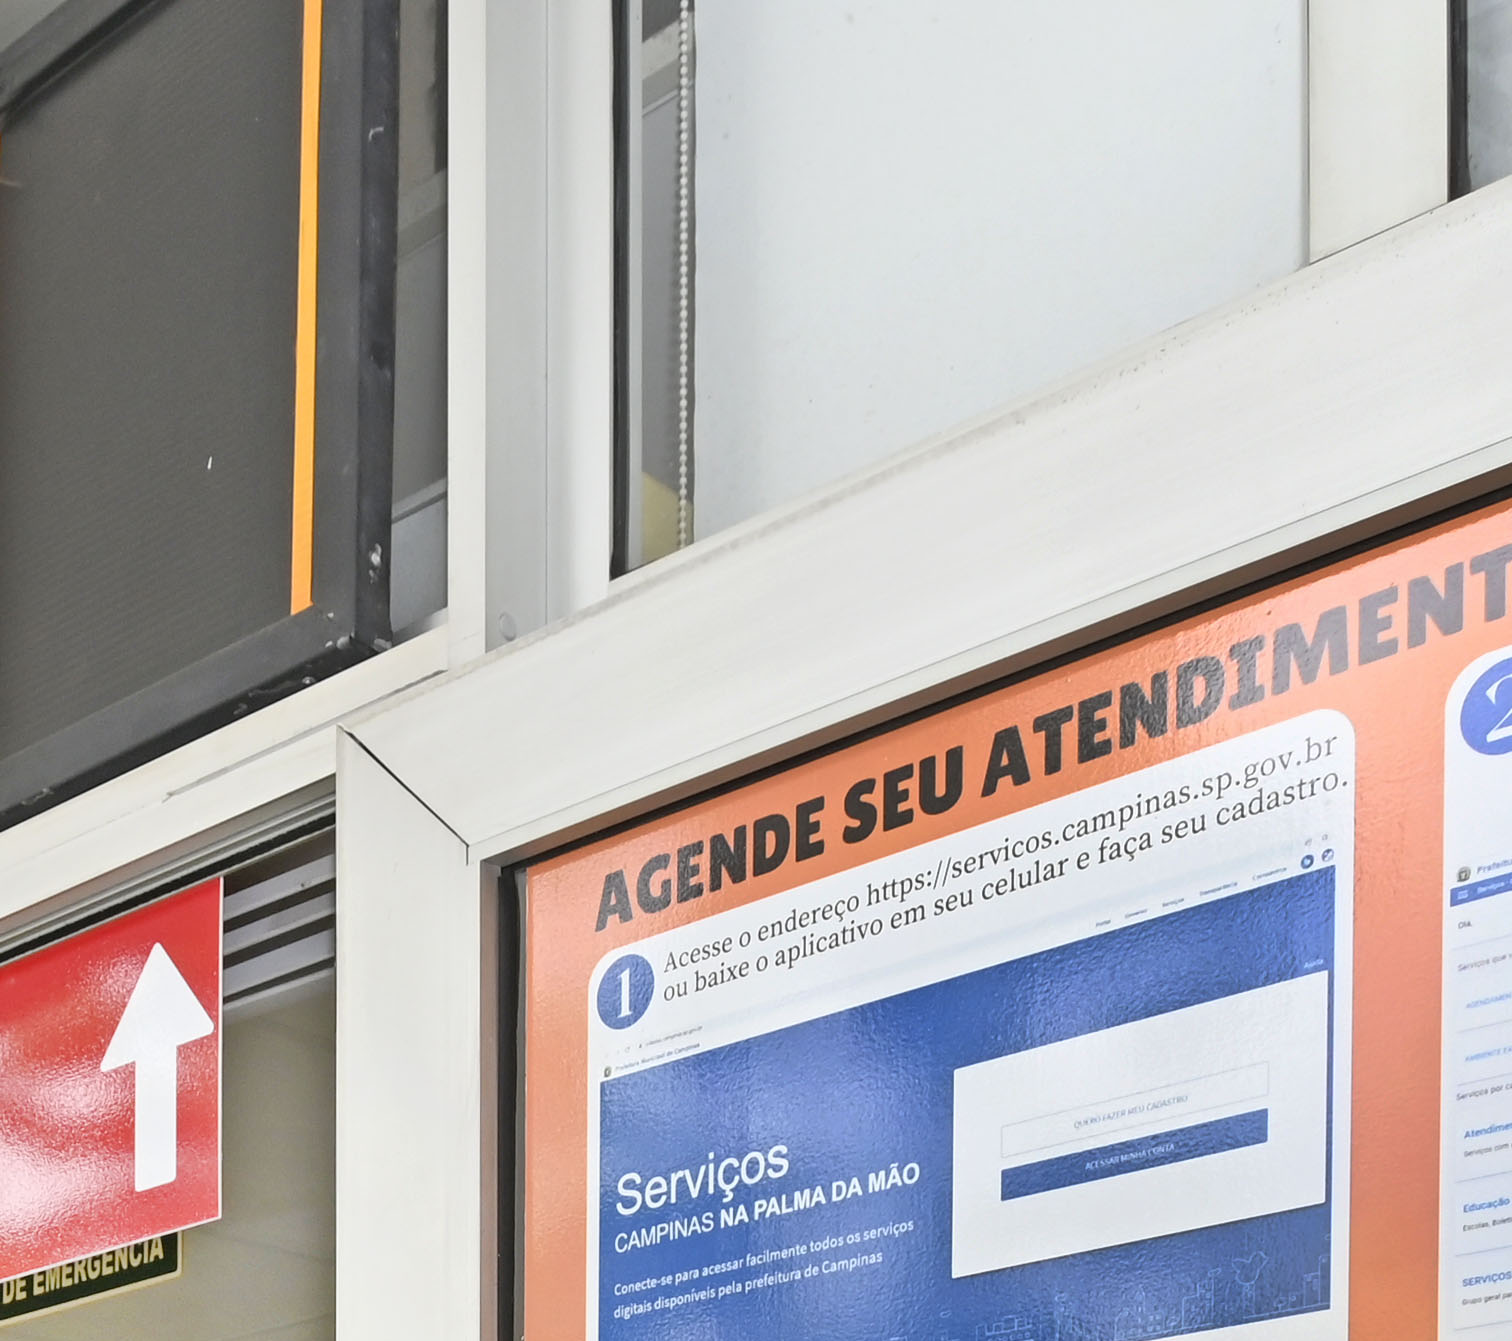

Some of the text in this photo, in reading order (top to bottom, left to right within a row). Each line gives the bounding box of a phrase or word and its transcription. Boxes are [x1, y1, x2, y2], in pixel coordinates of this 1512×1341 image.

[595, 795, 825, 932] AGENDE
[842, 745, 964, 845] SEU
[663, 735, 1338, 973] Acesse o endereço https://servicos.campinas.sp.gov.br
[616, 970, 634, 1018] 1
[614, 1162, 920, 1254] CAMPINAS NA PALMA DA MÃO
[616, 1142, 789, 1216] Serviços
[614, 1220, 914, 1296] Conecte-se para acessar facilmente todos os serviços
[1462, 1270, 1512, 1288] SERVIÇOS
